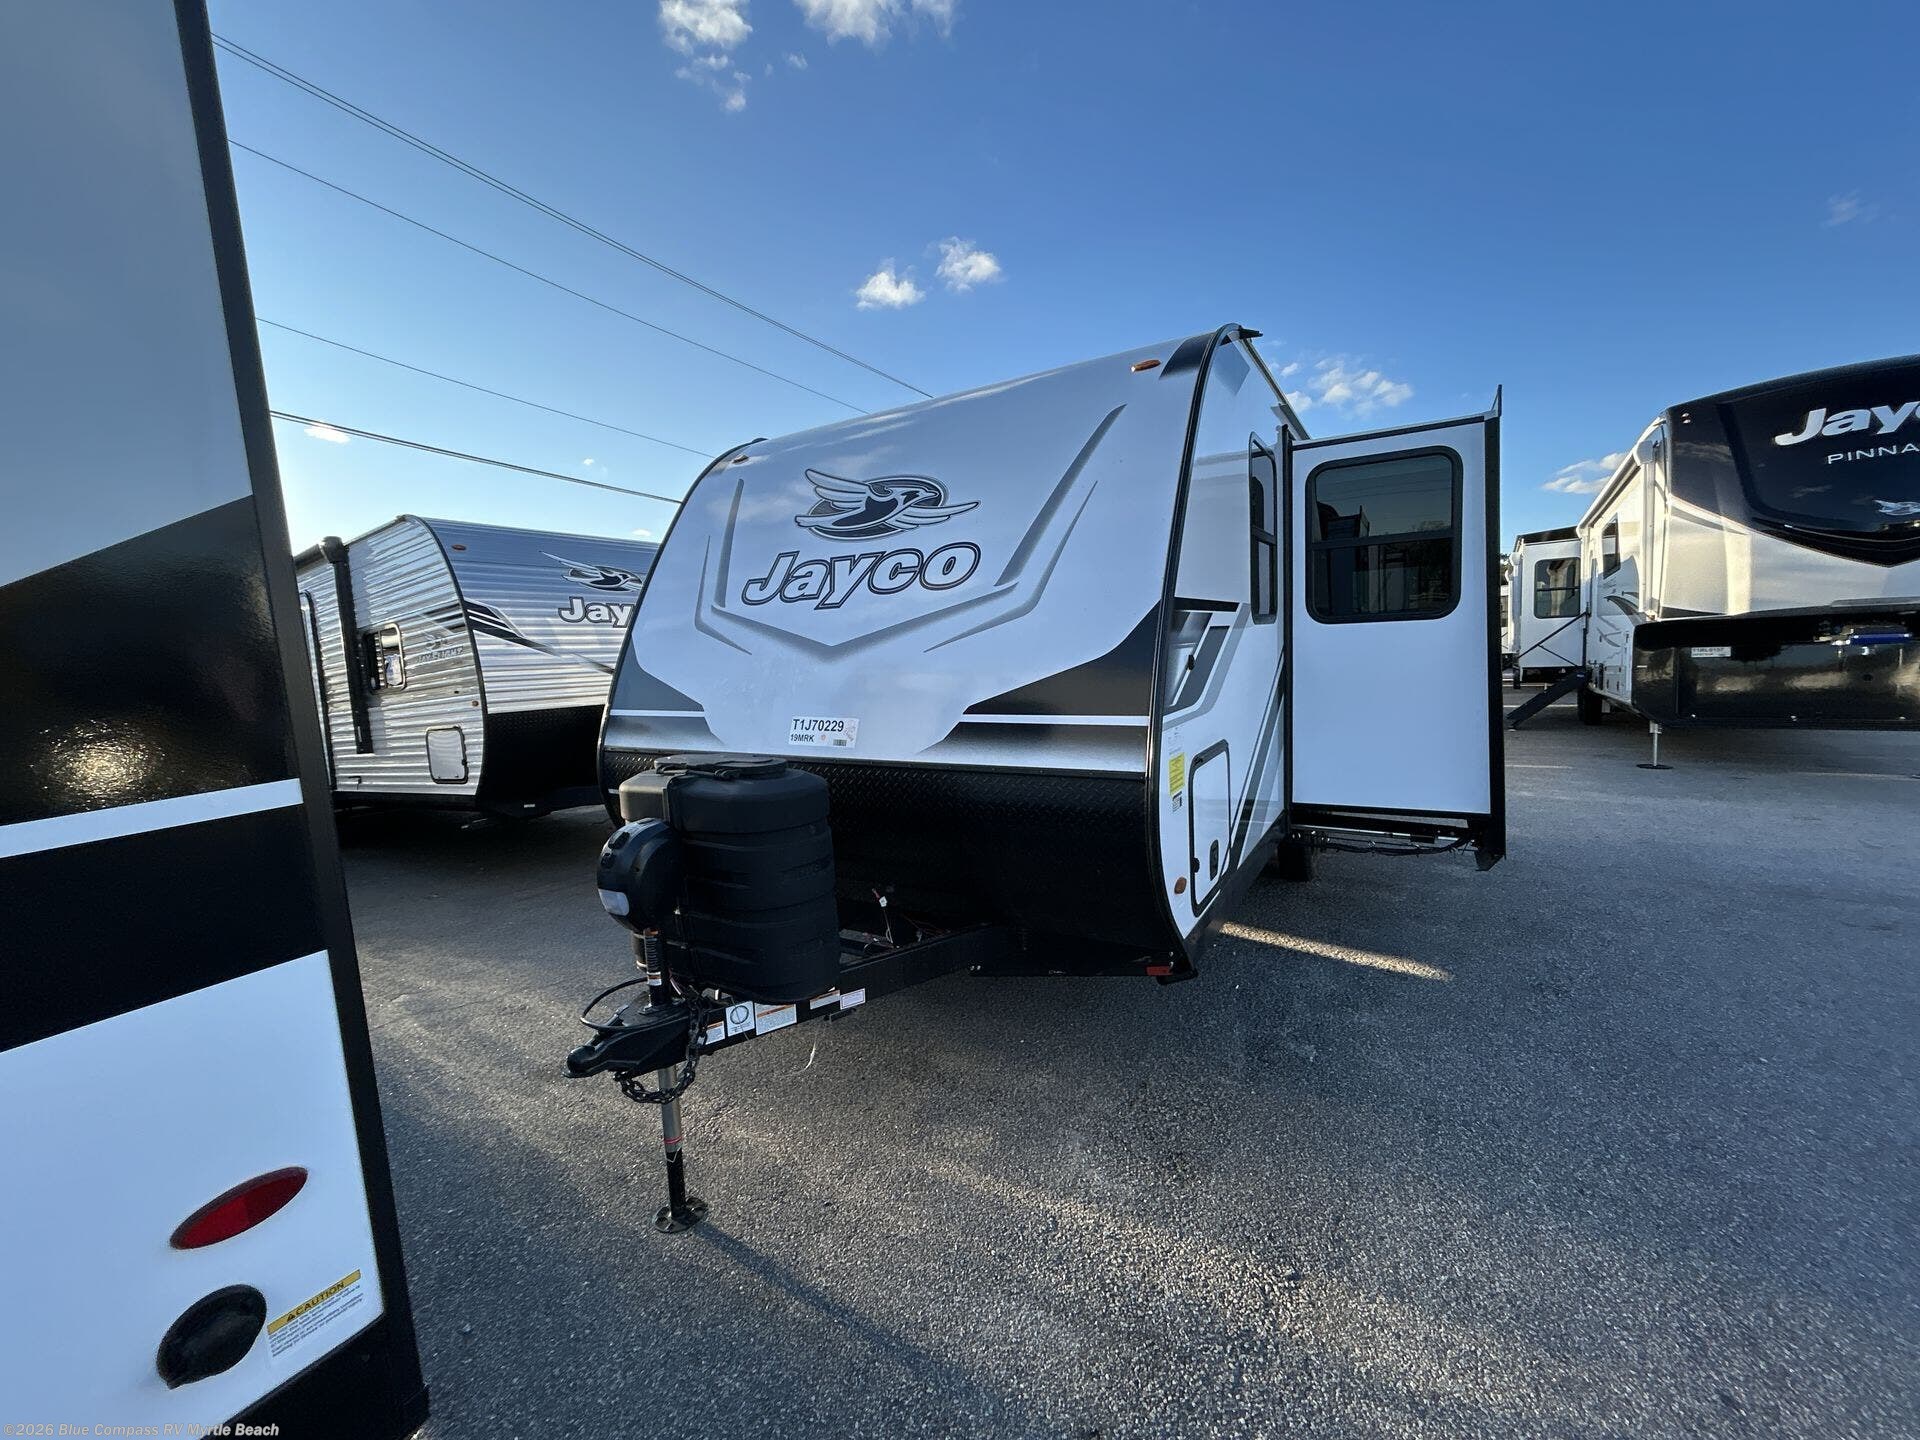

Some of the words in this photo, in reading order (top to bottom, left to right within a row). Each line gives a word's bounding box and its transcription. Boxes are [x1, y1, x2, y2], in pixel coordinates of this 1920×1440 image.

[1774, 401, 1920, 446] Jay
[741, 541, 981, 610] Jayco
[791, 734, 815, 742] 19MRK
[792, 719, 844, 732] T1J70229
[295, 1281, 345, 1316] CAUTION
